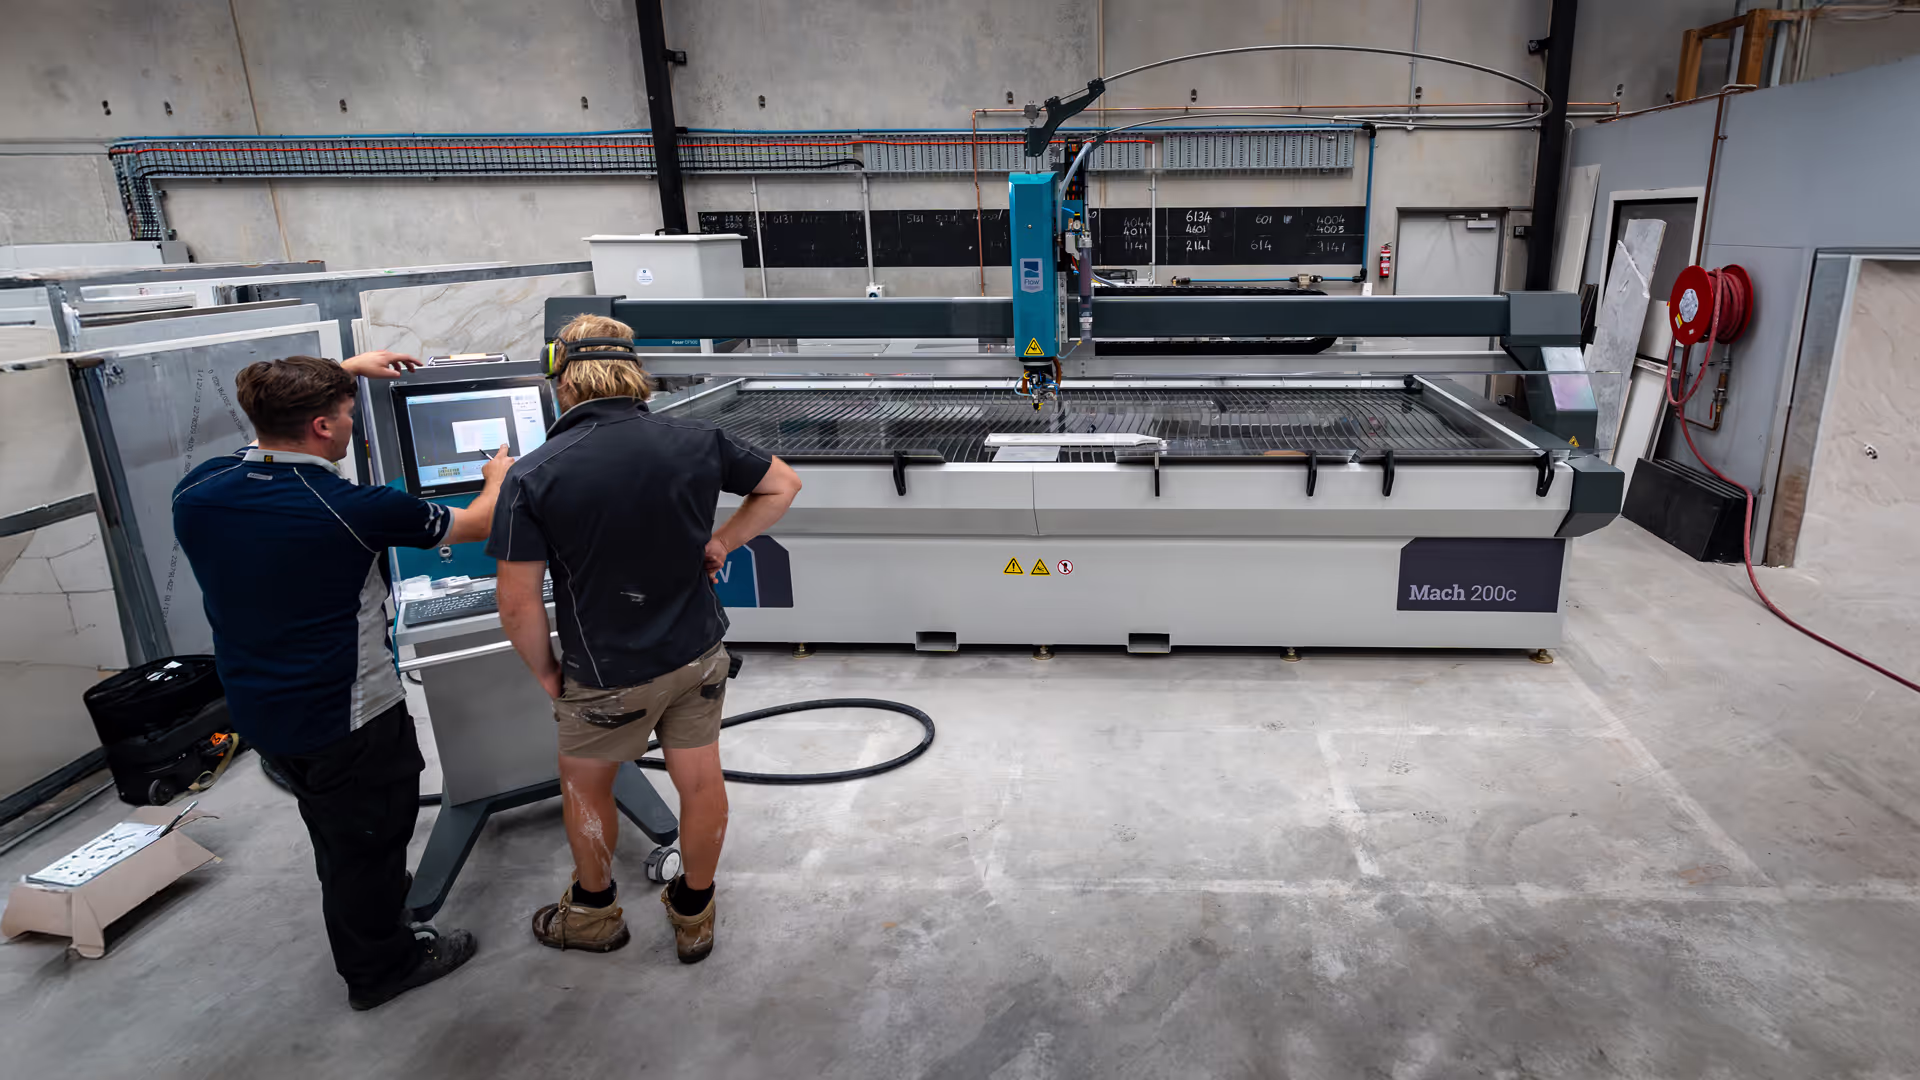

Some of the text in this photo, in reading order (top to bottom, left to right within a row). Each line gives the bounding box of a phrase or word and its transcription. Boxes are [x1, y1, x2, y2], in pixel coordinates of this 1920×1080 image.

[1185, 209, 1212, 223] 6134
[1256, 214, 1272, 224] 601
[1316, 214, 1345, 225] 4004
[1123, 216, 1152, 228] 4044
[1123, 226, 1148, 236] 4011
[1185, 223, 1207, 234] 4601
[1125, 240, 1148, 251] 1141
[1186, 239, 1211, 252] 2141
[1250, 239, 1272, 251] 614
[1408, 584, 1517, 601] Mach 200c
